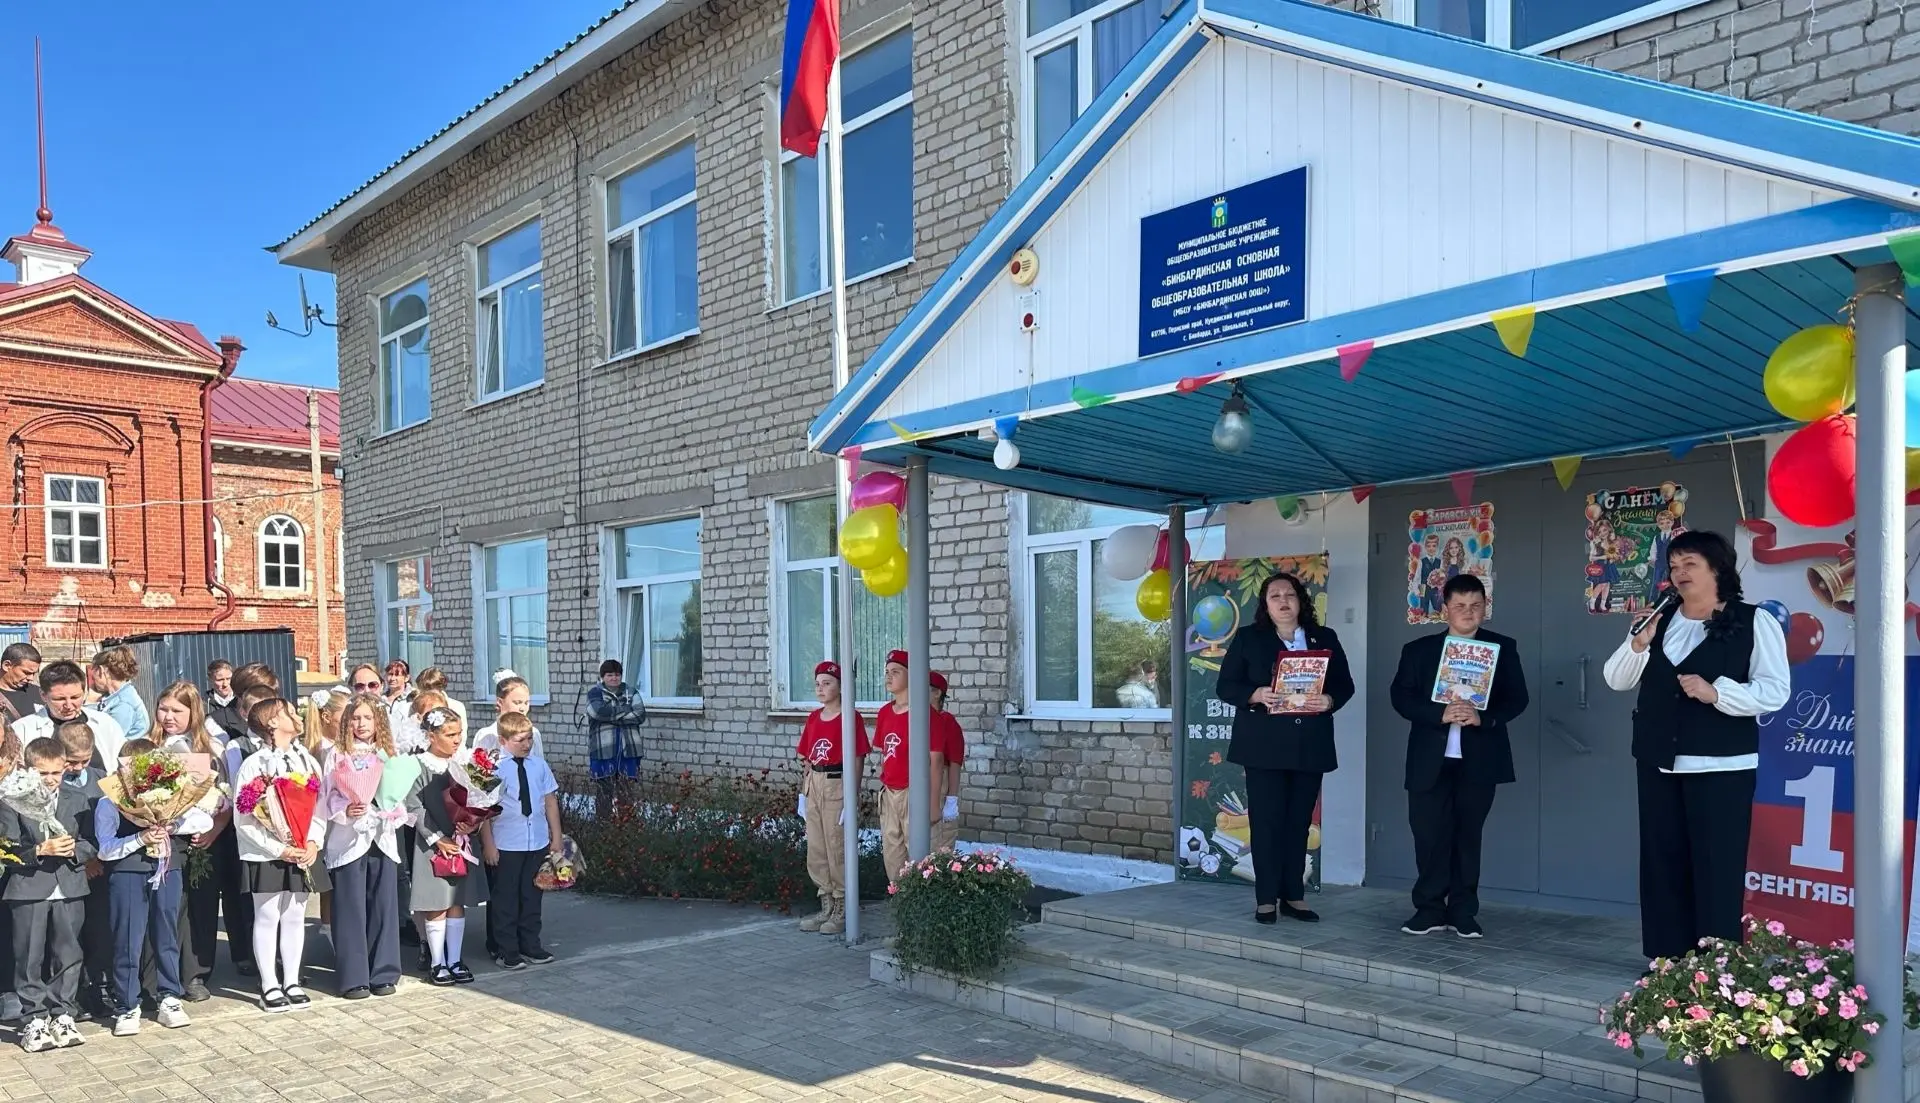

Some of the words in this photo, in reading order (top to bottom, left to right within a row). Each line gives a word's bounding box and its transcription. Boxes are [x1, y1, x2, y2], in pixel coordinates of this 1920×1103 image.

[1167, 240, 1237, 265] ОБЩЕОБРАЗОВАТЕЛЬНОЕ
[1239, 227, 1280, 246] УЧРЕЖДЕНИЕ
[1178, 231, 1226, 251] МУНИЦИПАЛЬНОЕ
[1228, 218, 1267, 236] БЮДЖЕТНОЕ
[1162, 259, 1231, 286] «БИКБАРДИНСКАЯ
[1237, 246, 1280, 267] ОСНОВНАЯ
[1152, 274, 1248, 308] ОБЩЕОБРАЗОВАТЕЛЬНАЯ
[1254, 265, 1290, 282] ШКОЛА»
[1173, 304, 1192, 318] (МБОУ
[1193, 292, 1247, 311] «БИКБАРДИНСКАЯ
[1248, 286, 1270, 298] ООШ»)
[1604, 495, 1615, 509] С
[1617, 492, 1666, 509] ДНЁМ
[1787, 690, 1854, 732] Днё
[1785, 765, 1844, 872] 1
[1745, 871, 1854, 907] СЕНТЯБ
